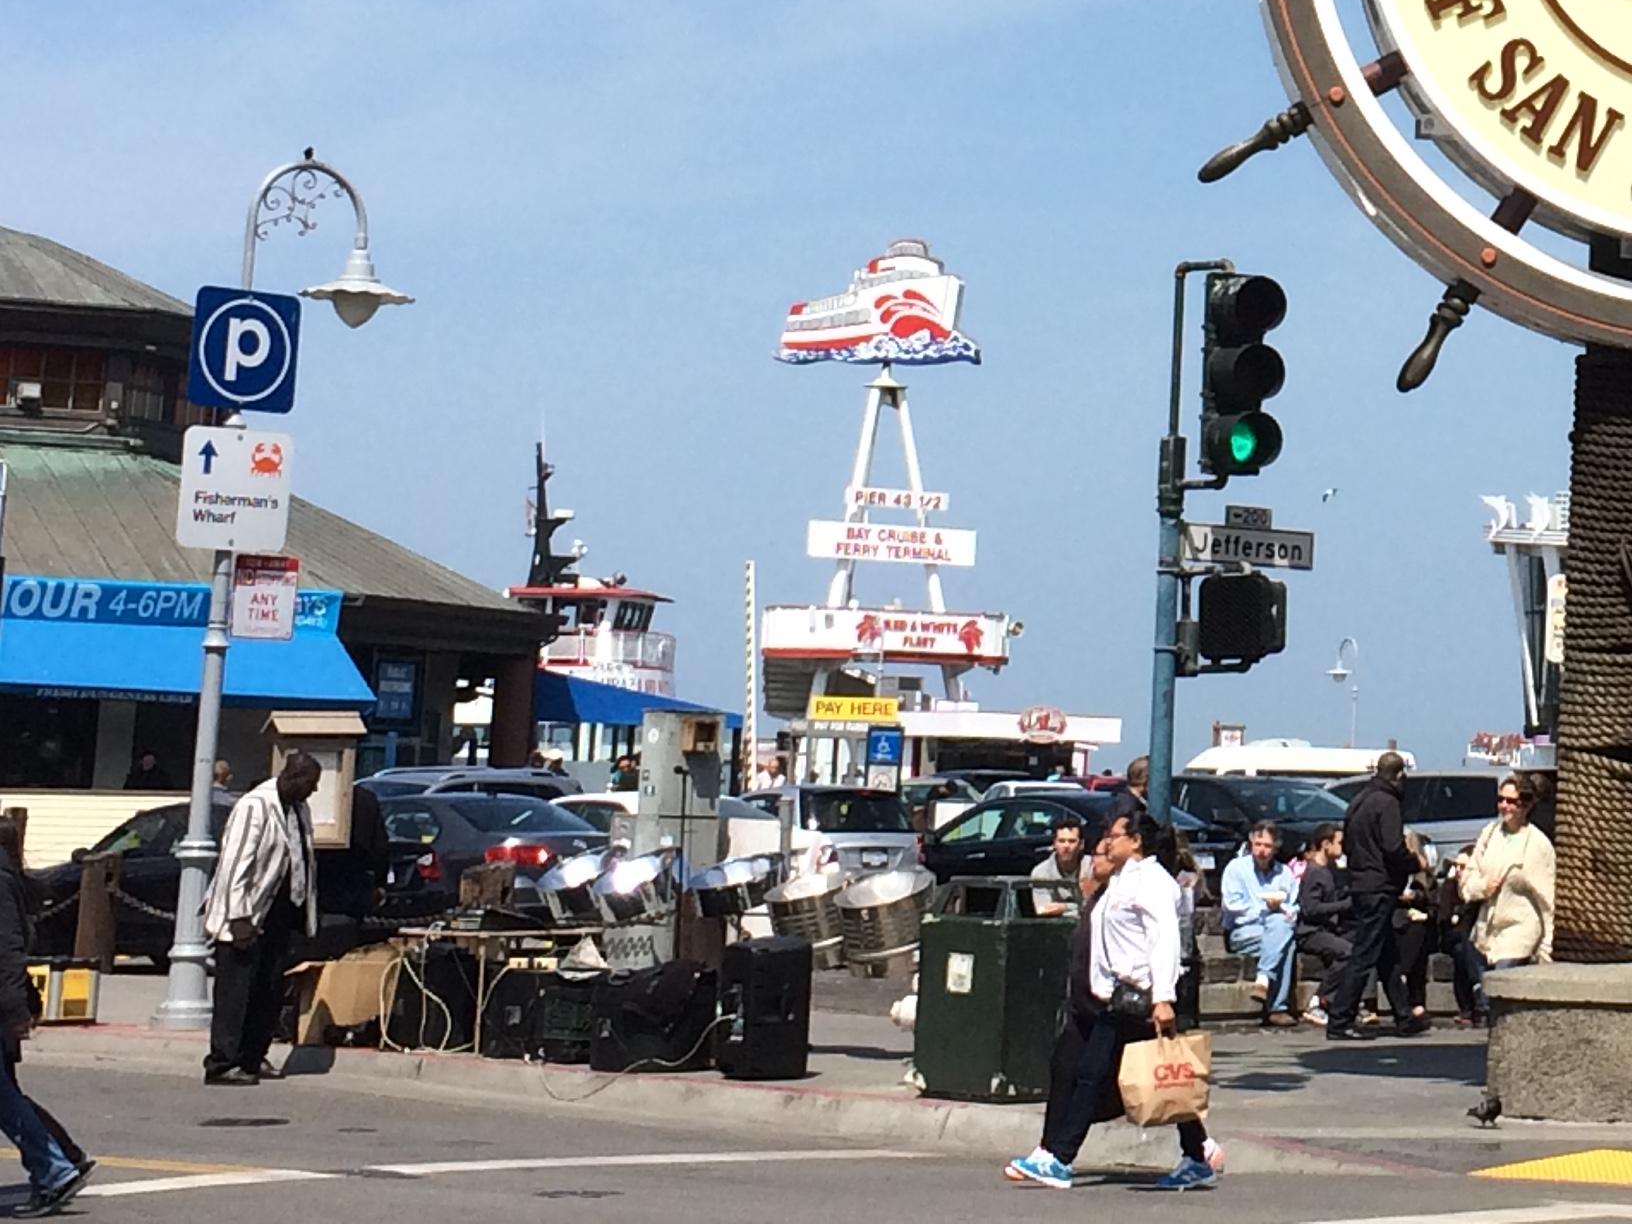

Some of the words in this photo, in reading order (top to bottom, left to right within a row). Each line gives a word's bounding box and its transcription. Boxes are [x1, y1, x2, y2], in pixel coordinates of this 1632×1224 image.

[1468, 37, 1626, 180] SAN
[223, 317, 271, 382] P
[194, 490, 279, 510] Fisherman's
[855, 491, 886, 505] PIER
[893, 493, 912, 508] 43
[919, 495, 942, 509] 1/2
[193, 509, 236, 524] Wharf
[846, 527, 872, 541] BAY
[878, 528, 927, 543] CRUISE
[835, 542, 879, 557] FERRY
[886, 545, 952, 562] TERMINAL
[1195, 533, 1303, 561] Jefferson
[108, 589, 205, 620] 4-6PM
[250, 592, 279, 606] ANY
[248, 607, 278, 622] TIME
[920, 621, 958, 635] WHITE
[815, 700, 843, 714] PAY
[850, 702, 893, 716] HERE
[1153, 1062, 1195, 1081] CVS
